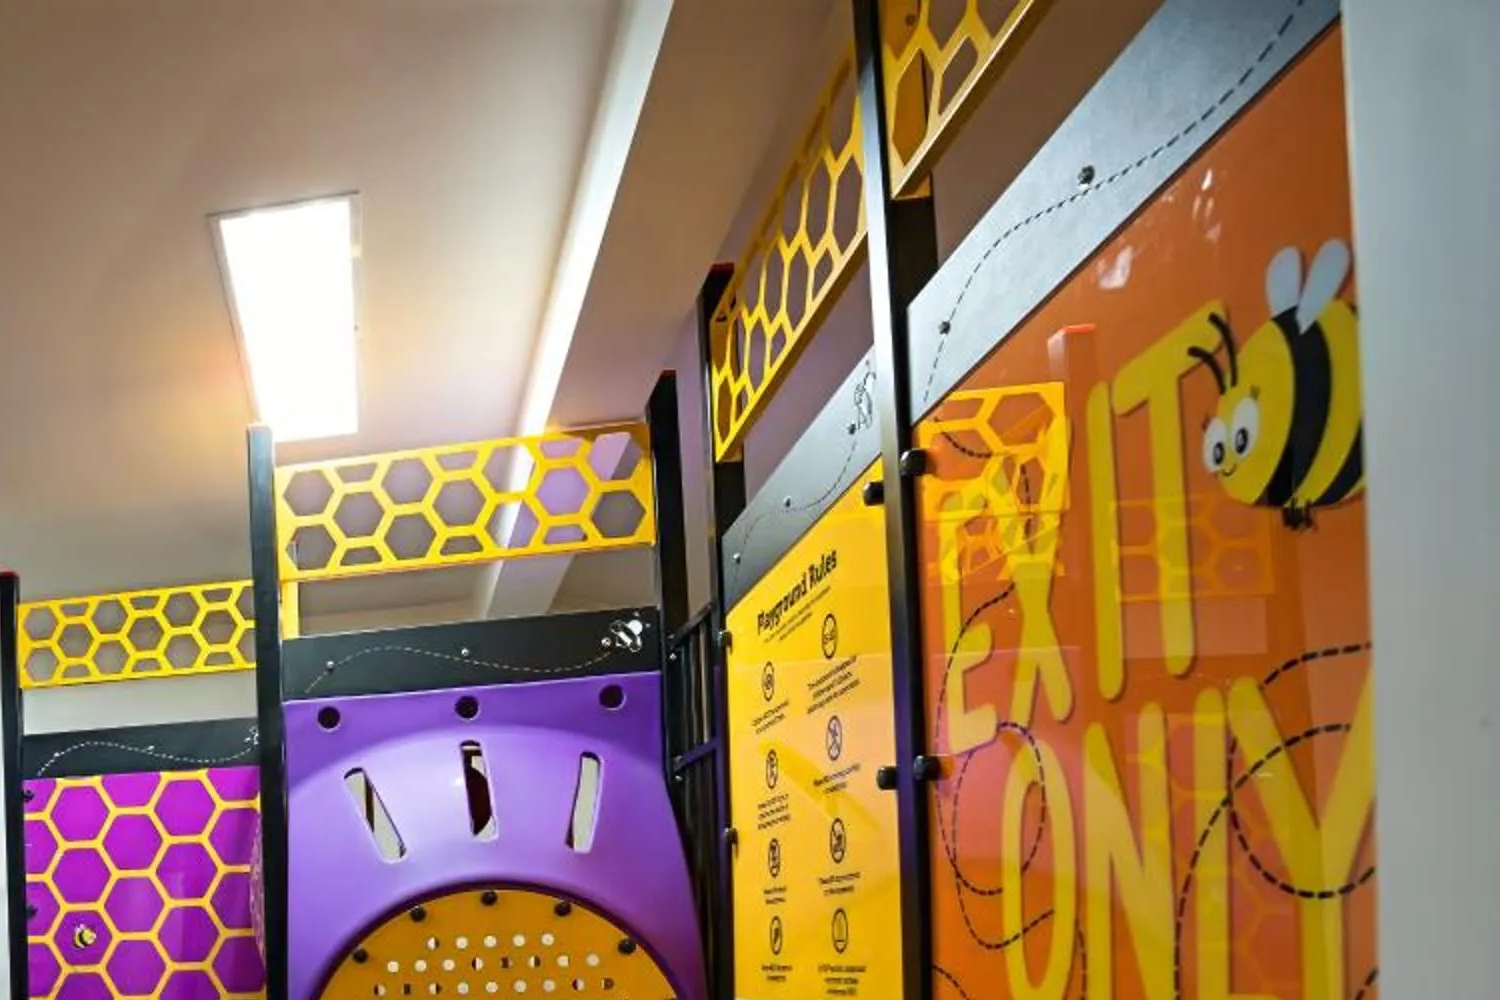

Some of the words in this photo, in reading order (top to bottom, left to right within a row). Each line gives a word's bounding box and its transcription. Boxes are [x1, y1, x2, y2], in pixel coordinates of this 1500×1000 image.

[757, 570, 808, 635] Playground
[809, 550, 837, 587] Rules
[939, 299, 1226, 755] EXIT
